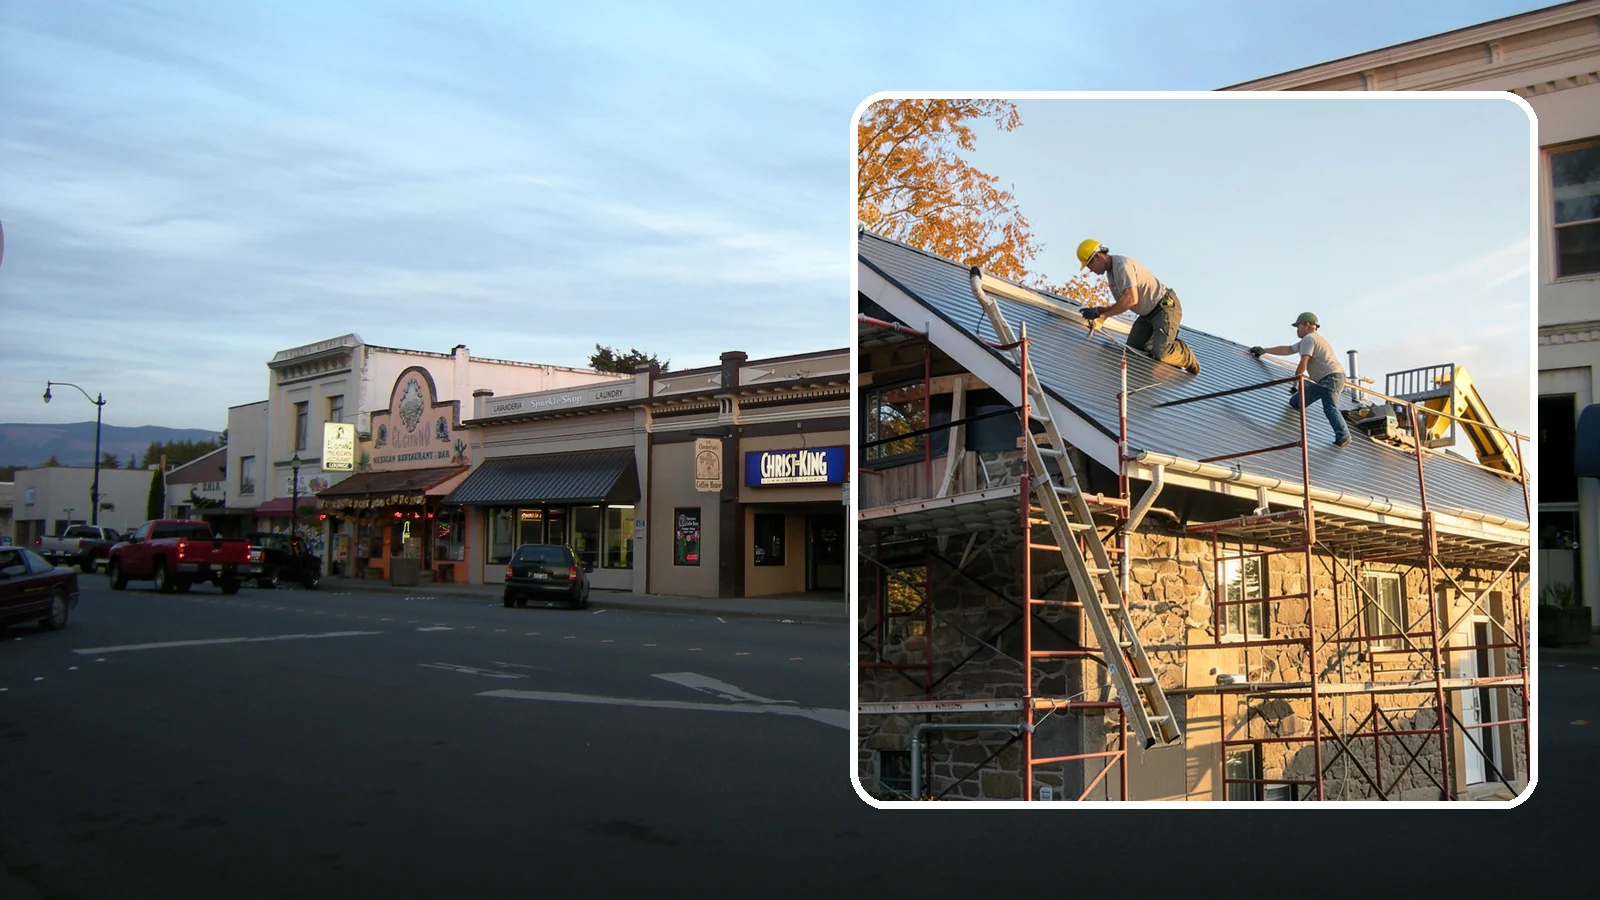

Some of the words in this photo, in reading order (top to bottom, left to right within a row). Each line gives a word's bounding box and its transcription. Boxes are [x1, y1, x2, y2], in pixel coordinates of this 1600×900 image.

[493, 402, 522, 412] LAVANDERIA
[531, 398, 560, 408] Sparkle
[562, 394, 582, 405] Shop
[595, 389, 623, 399] LAUNDRY
[398, 451, 433, 462] RESTAURANT
[438, 449, 450, 459] BAR
[761, 452, 798, 478] CHRIST
[799, 449, 827, 476] KING
